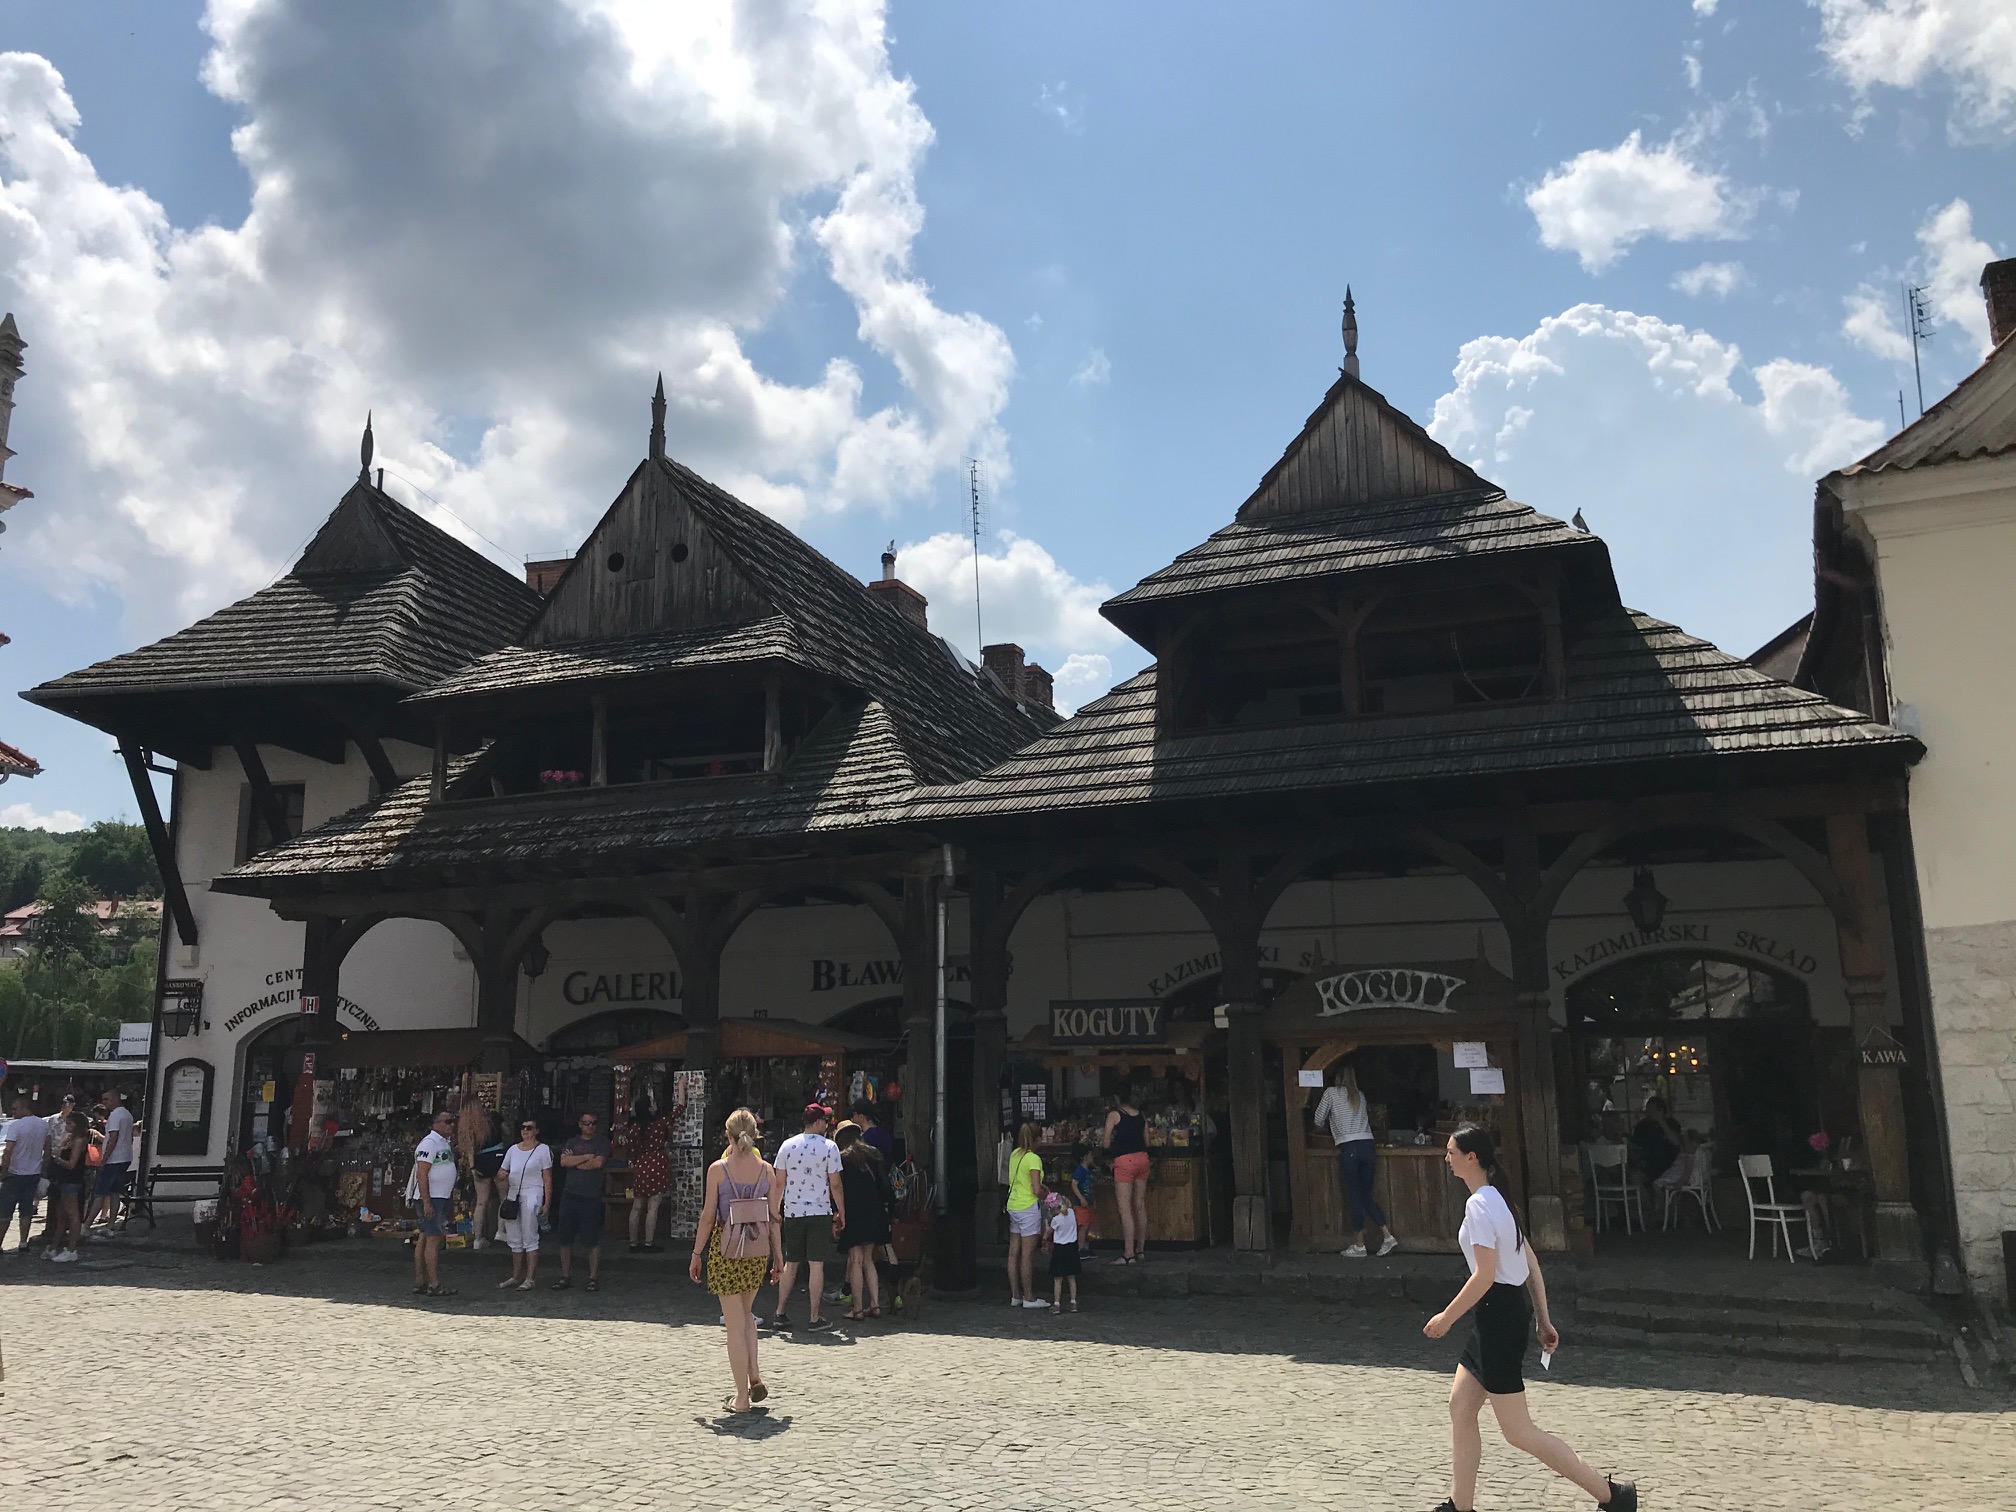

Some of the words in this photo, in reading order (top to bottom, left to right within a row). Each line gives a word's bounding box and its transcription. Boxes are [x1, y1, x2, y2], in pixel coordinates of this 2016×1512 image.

[265, 968, 304, 986] CENT
[562, 970, 684, 1006] GALERI
[1148, 946, 1280, 996] KAZIMIKI
[224, 988, 295, 1033] INFORMACJI
[1315, 967, 1467, 1018] KOGUTY
[1052, 1006, 1161, 1037] KOGUTY
[1861, 1049, 1907, 1064] KAWA
